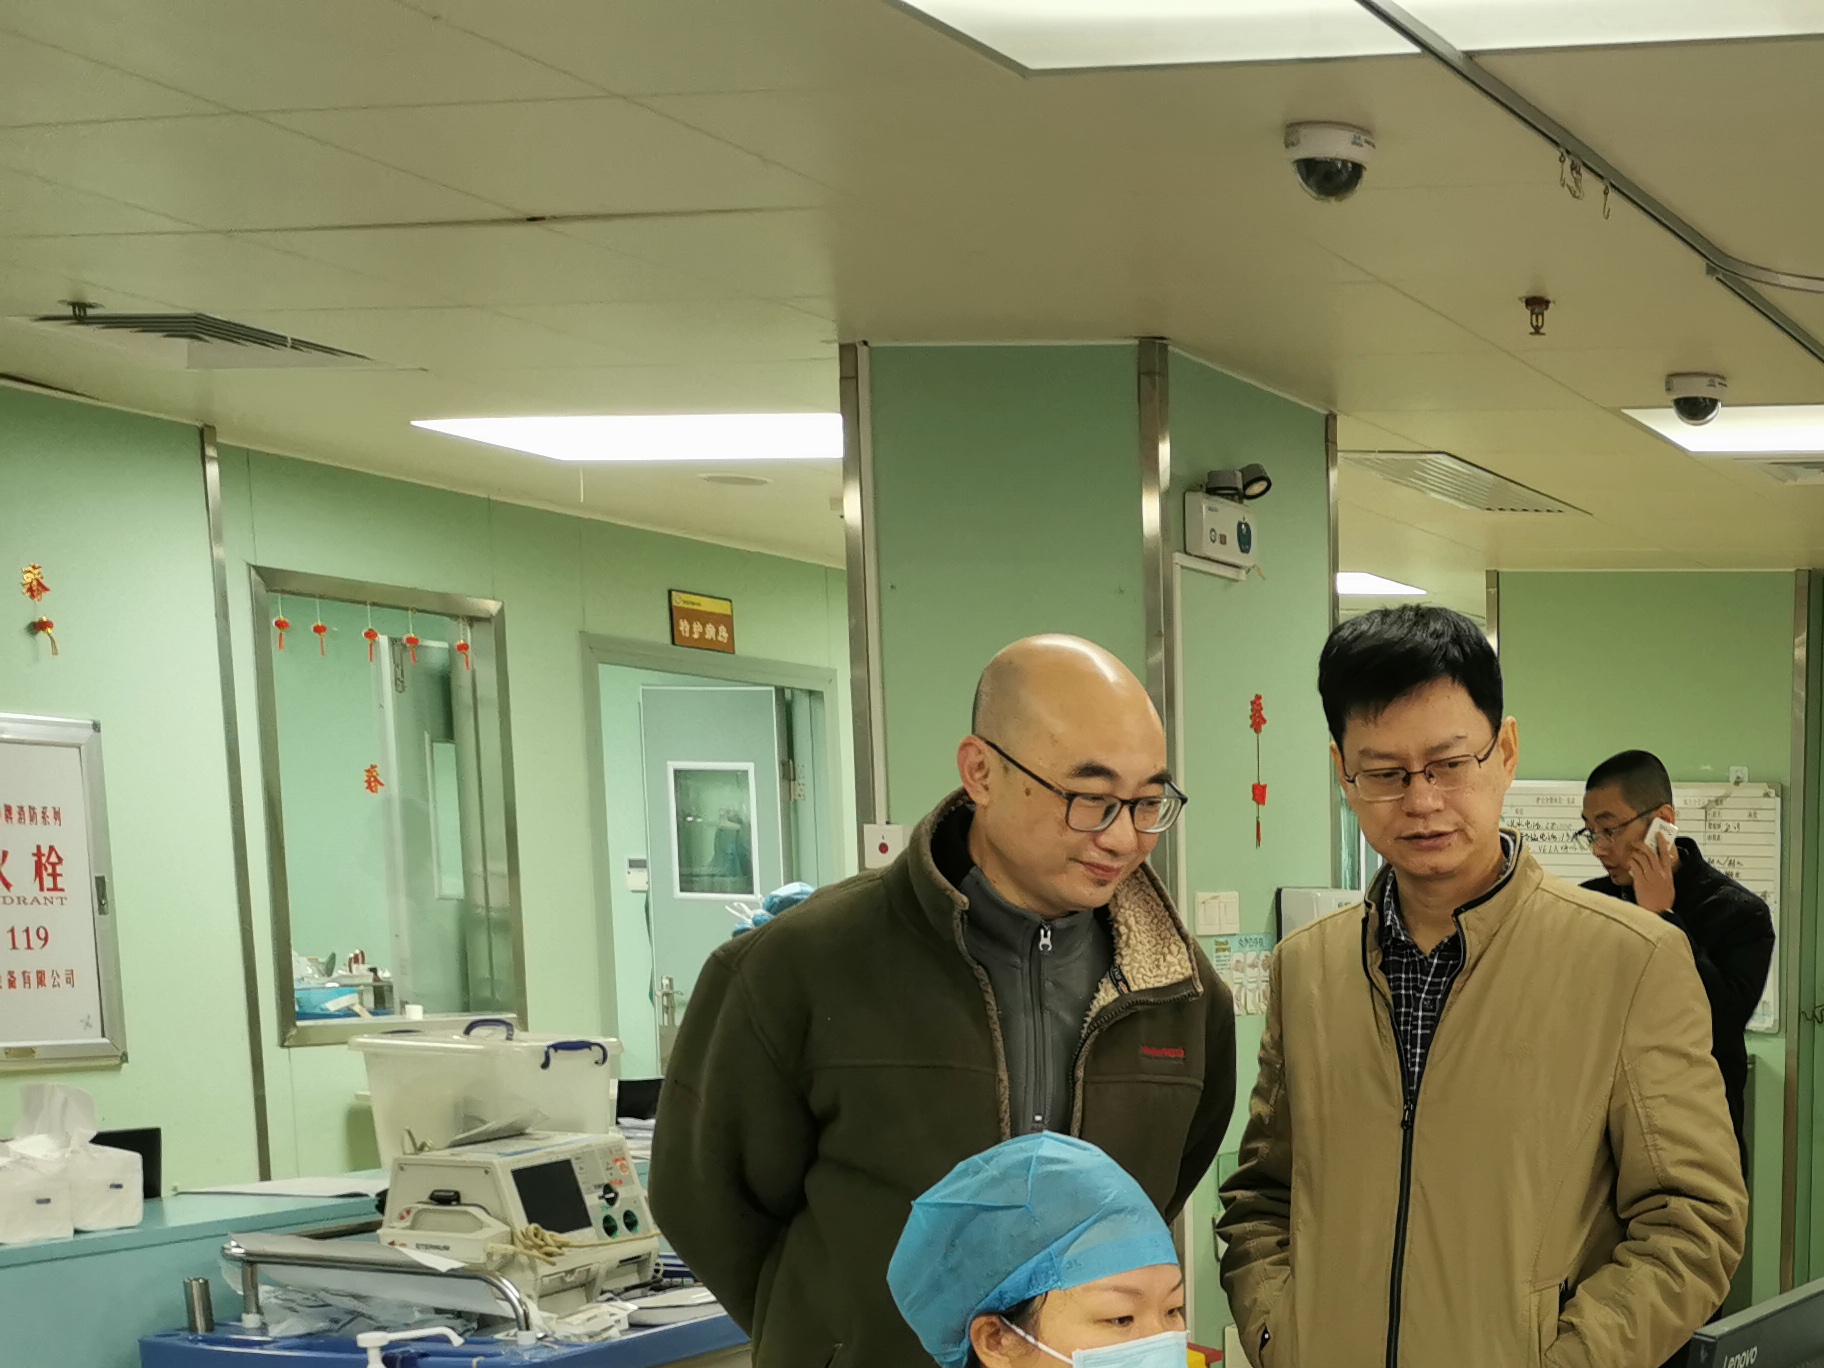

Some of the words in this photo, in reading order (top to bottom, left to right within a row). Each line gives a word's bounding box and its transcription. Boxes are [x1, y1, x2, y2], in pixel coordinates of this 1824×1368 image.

[0, 803, 62, 827] 牌消防系列
[2, 895, 68, 906] DRANT
[7, 925, 50, 951] 119
[0, 969, 75, 989] 备有限公司
